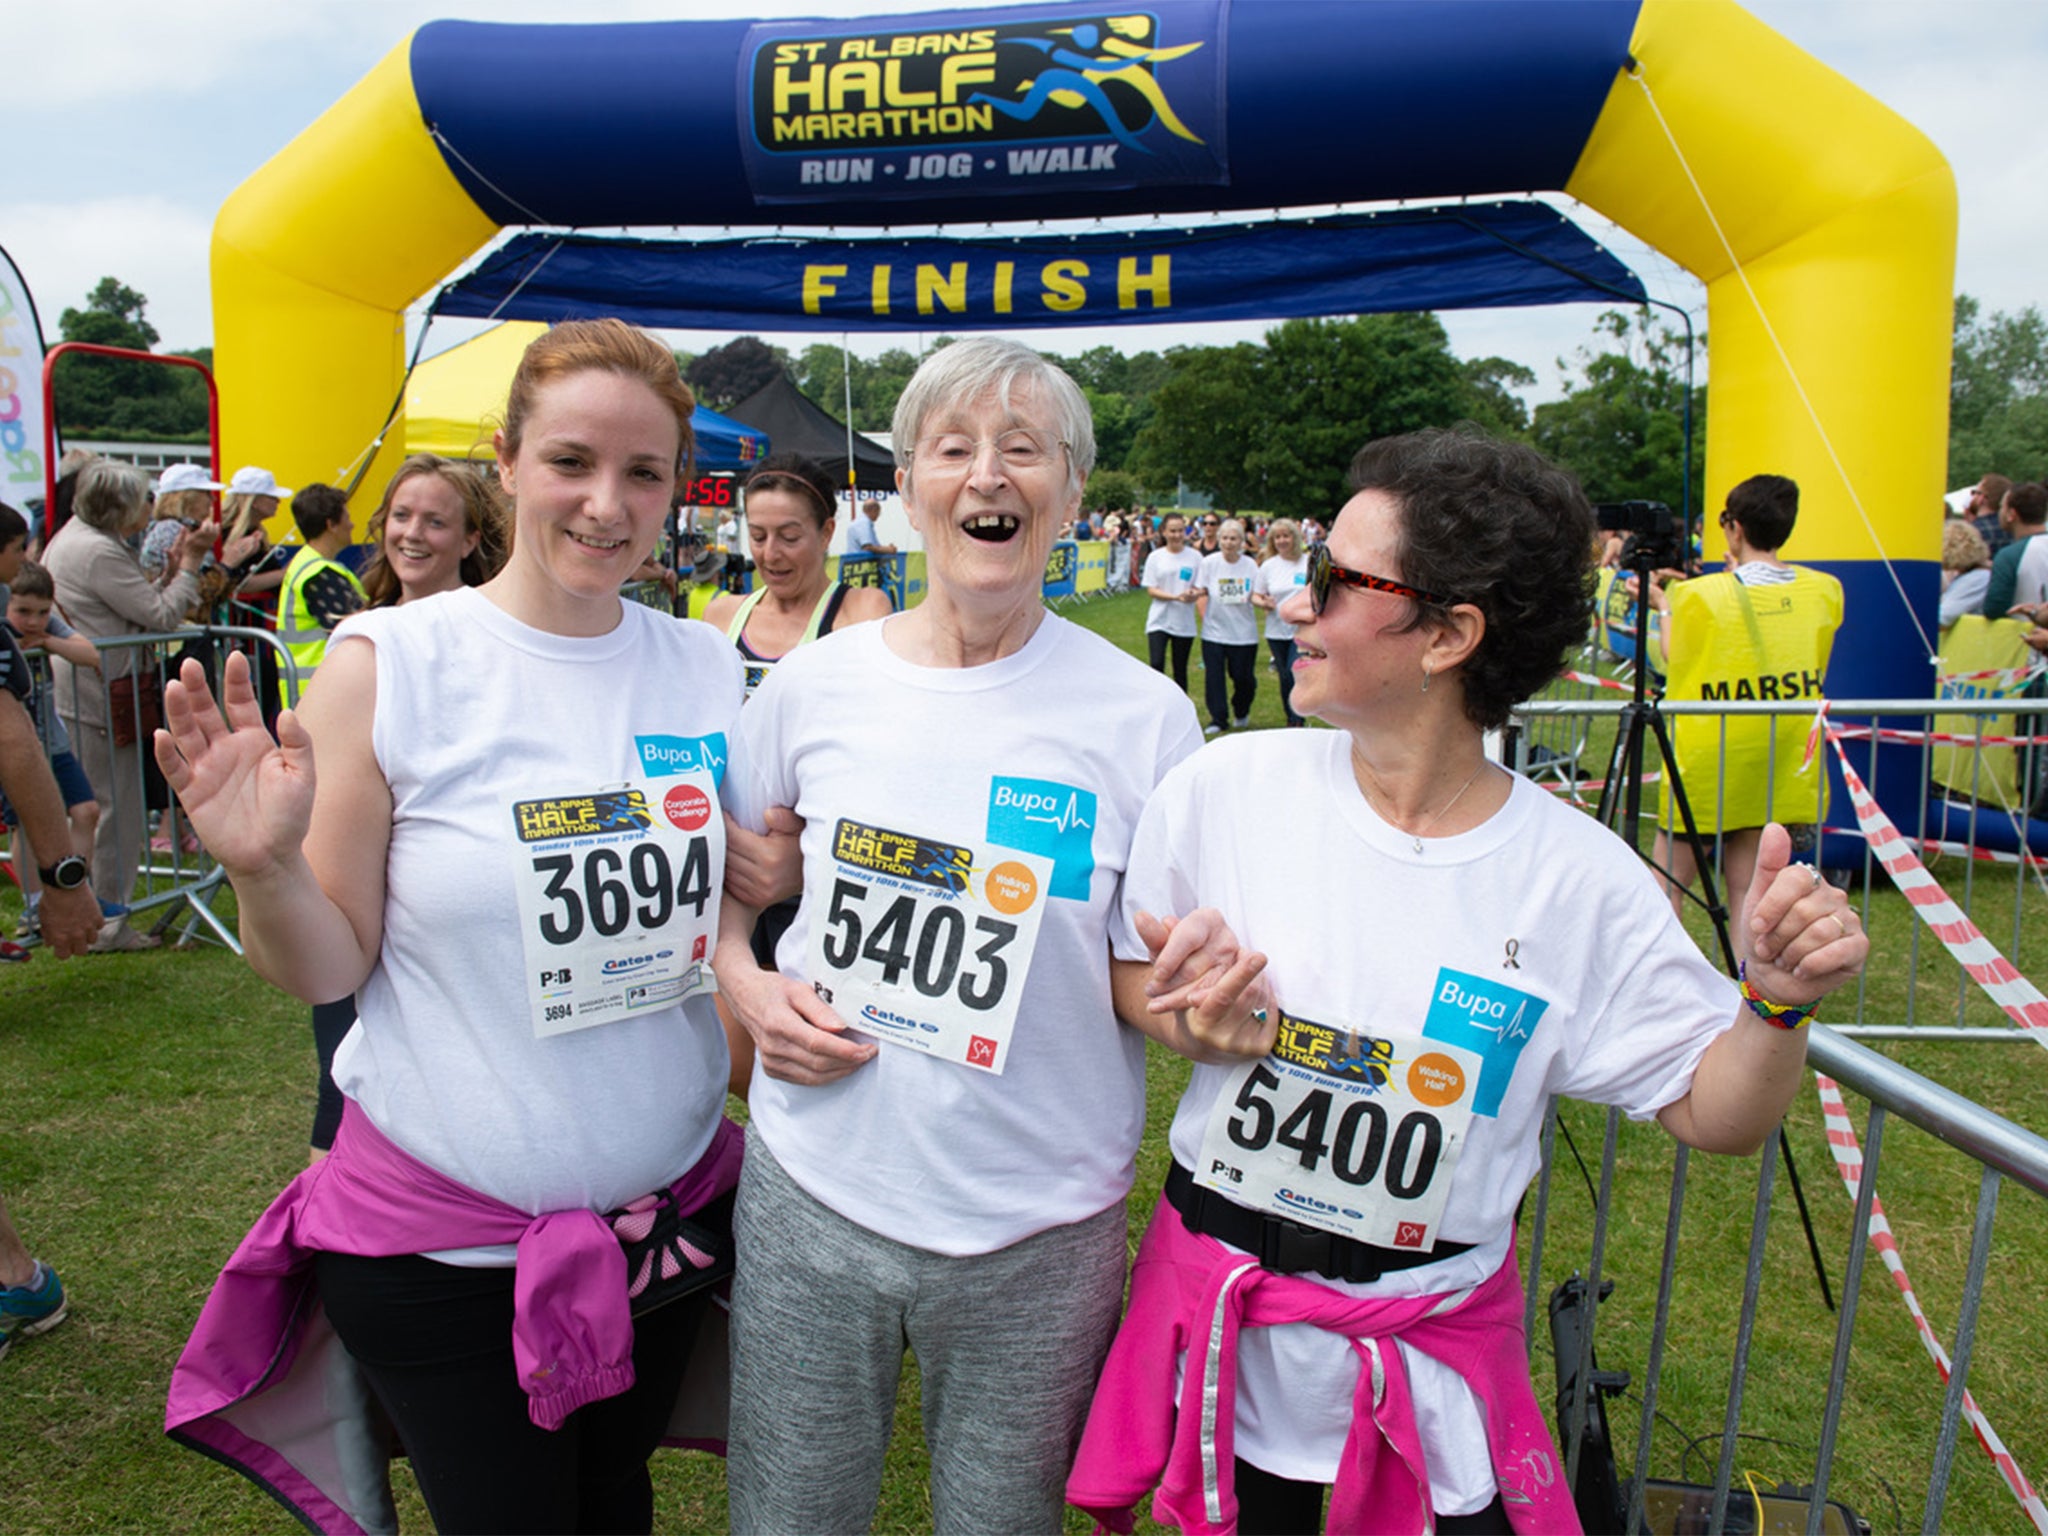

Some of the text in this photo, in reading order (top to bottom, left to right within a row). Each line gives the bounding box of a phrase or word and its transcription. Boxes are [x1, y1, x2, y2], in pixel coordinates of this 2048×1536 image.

[774, 30, 997, 64] ST ALBANS
[773, 51, 997, 114] HALF
[772, 104, 994, 142] MARATHON
[801, 144, 1119, 185] RUN JOG WALK
[802, 254, 1171, 315] FINISH
[644, 742, 692, 765] Bupa
[519, 798, 595, 814] ST ALBANS
[664, 798, 707, 810] Corporate
[995, 786, 1058, 812] Bupa
[520, 807, 597, 830] HALF
[669, 807, 708, 818] Challenge
[525, 823, 600, 839] MARATHON
[842, 822, 918, 849] ST ALBANS
[531, 842, 571, 853] Sunday
[838, 831, 917, 863] HALF
[836, 848, 913, 876] MARATHON
[837, 865, 874, 882] Sunday
[533, 836, 712, 946] 3694
[995, 874, 1030, 894] Walking
[1000, 886, 1020, 899] Half
[823, 878, 1018, 1011] 5403
[545, 1003, 573, 1022] 3694
[1438, 980, 1507, 1019] Bupa
[1288, 1068, 1314, 1081] 10th
[1314, 1077, 1342, 1089] June
[1344, 1084, 1374, 1096] 2018
[1418, 1065, 1458, 1086] Walking
[1424, 1079, 1446, 1091] Half
[1227, 1063, 1443, 1200] 5400
